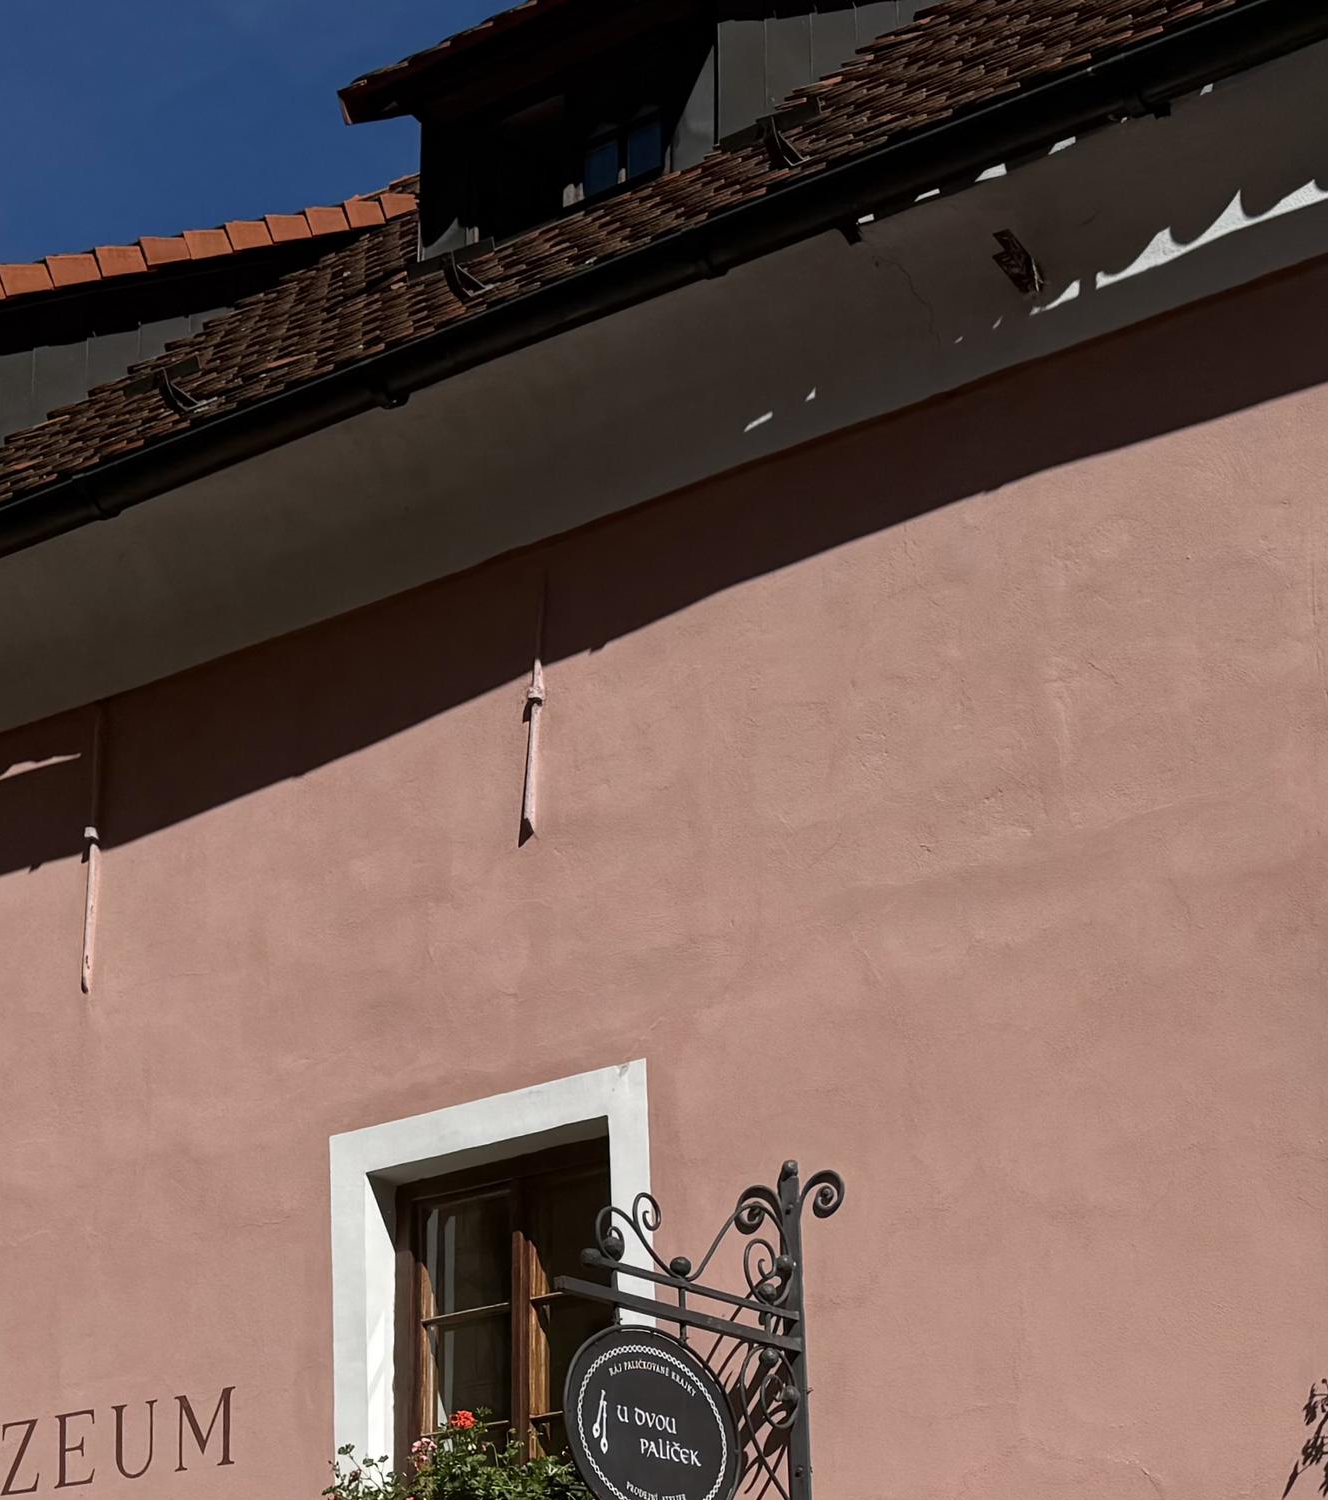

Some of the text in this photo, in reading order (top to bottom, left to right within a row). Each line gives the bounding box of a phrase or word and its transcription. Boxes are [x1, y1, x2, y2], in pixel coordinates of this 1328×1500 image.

[671, 1371, 697, 1396] KRAJKY
[616, 1404, 677, 1434] U DVOU
[640, 1438, 702, 1467] PALIČEK
